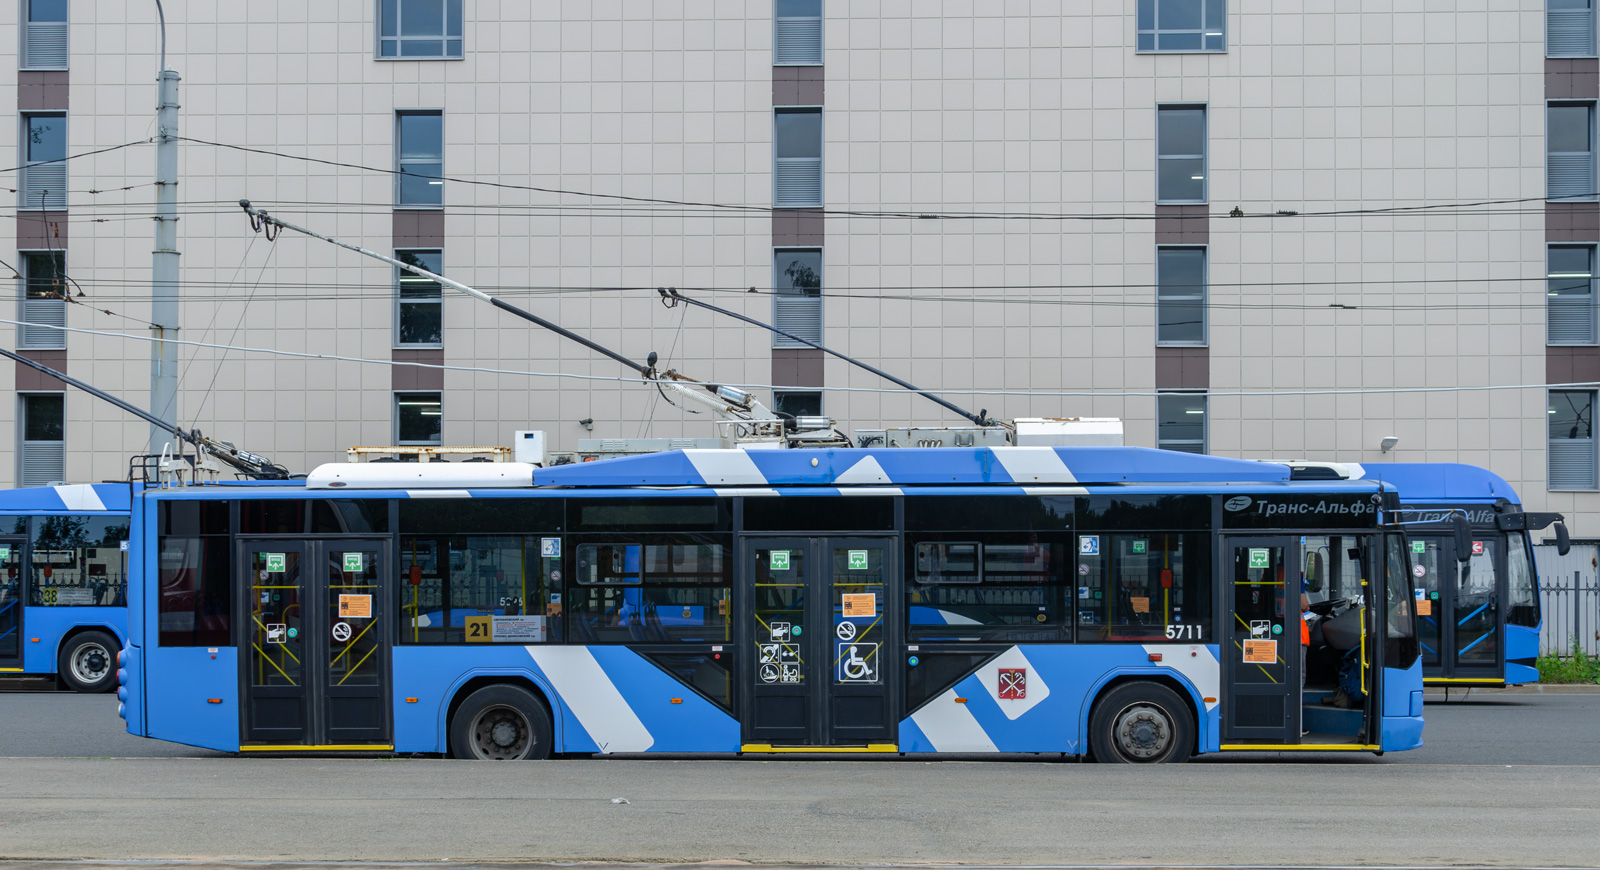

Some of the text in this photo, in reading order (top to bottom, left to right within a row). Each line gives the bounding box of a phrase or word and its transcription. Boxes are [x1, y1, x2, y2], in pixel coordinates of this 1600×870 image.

[1256, 500, 1376, 517] Транс-Альфа
[44, 590, 57, 603] 38
[469, 622, 488, 637] 21
[1165, 624, 1202, 639] 5711
